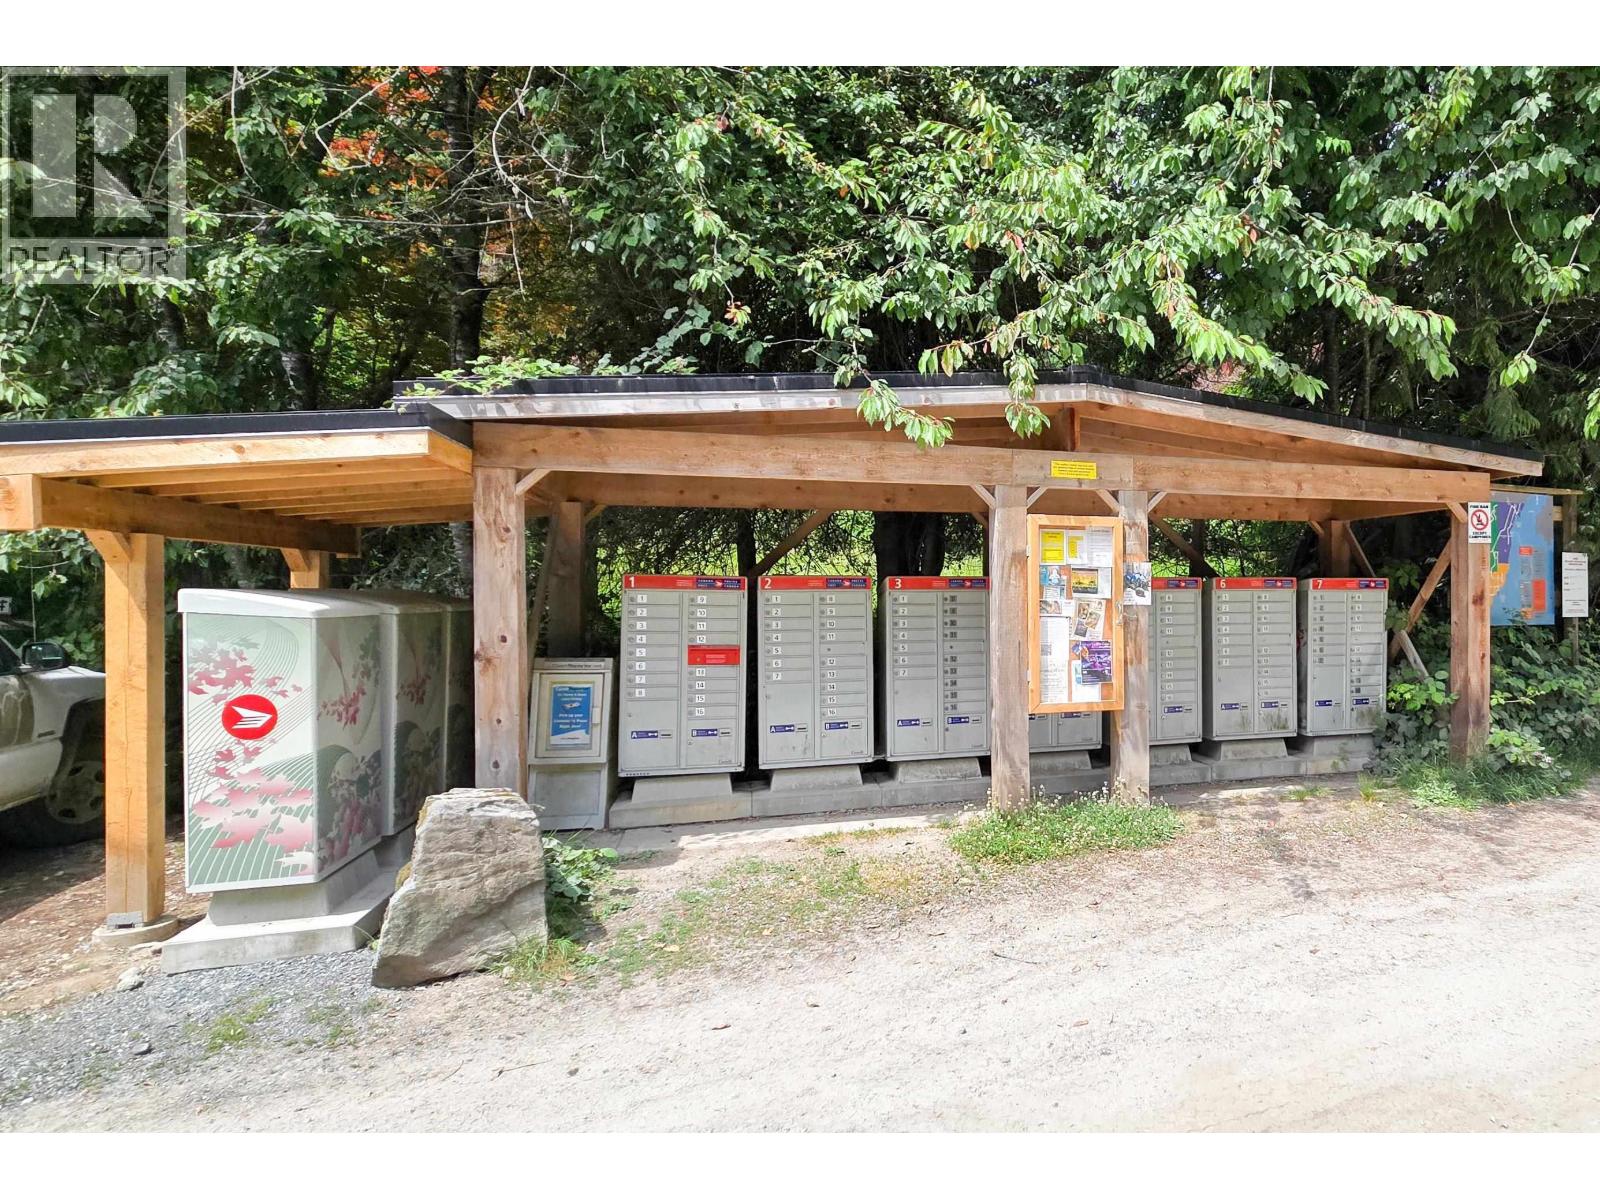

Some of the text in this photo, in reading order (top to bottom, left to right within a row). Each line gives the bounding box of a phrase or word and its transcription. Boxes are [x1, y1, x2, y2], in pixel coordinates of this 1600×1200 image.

[629, 576, 635, 588] 1
[764, 578, 771, 589] 2
[895, 579, 902, 589] 3
[1220, 579, 1226, 588] 6
[1317, 579, 1322, 590] 7
